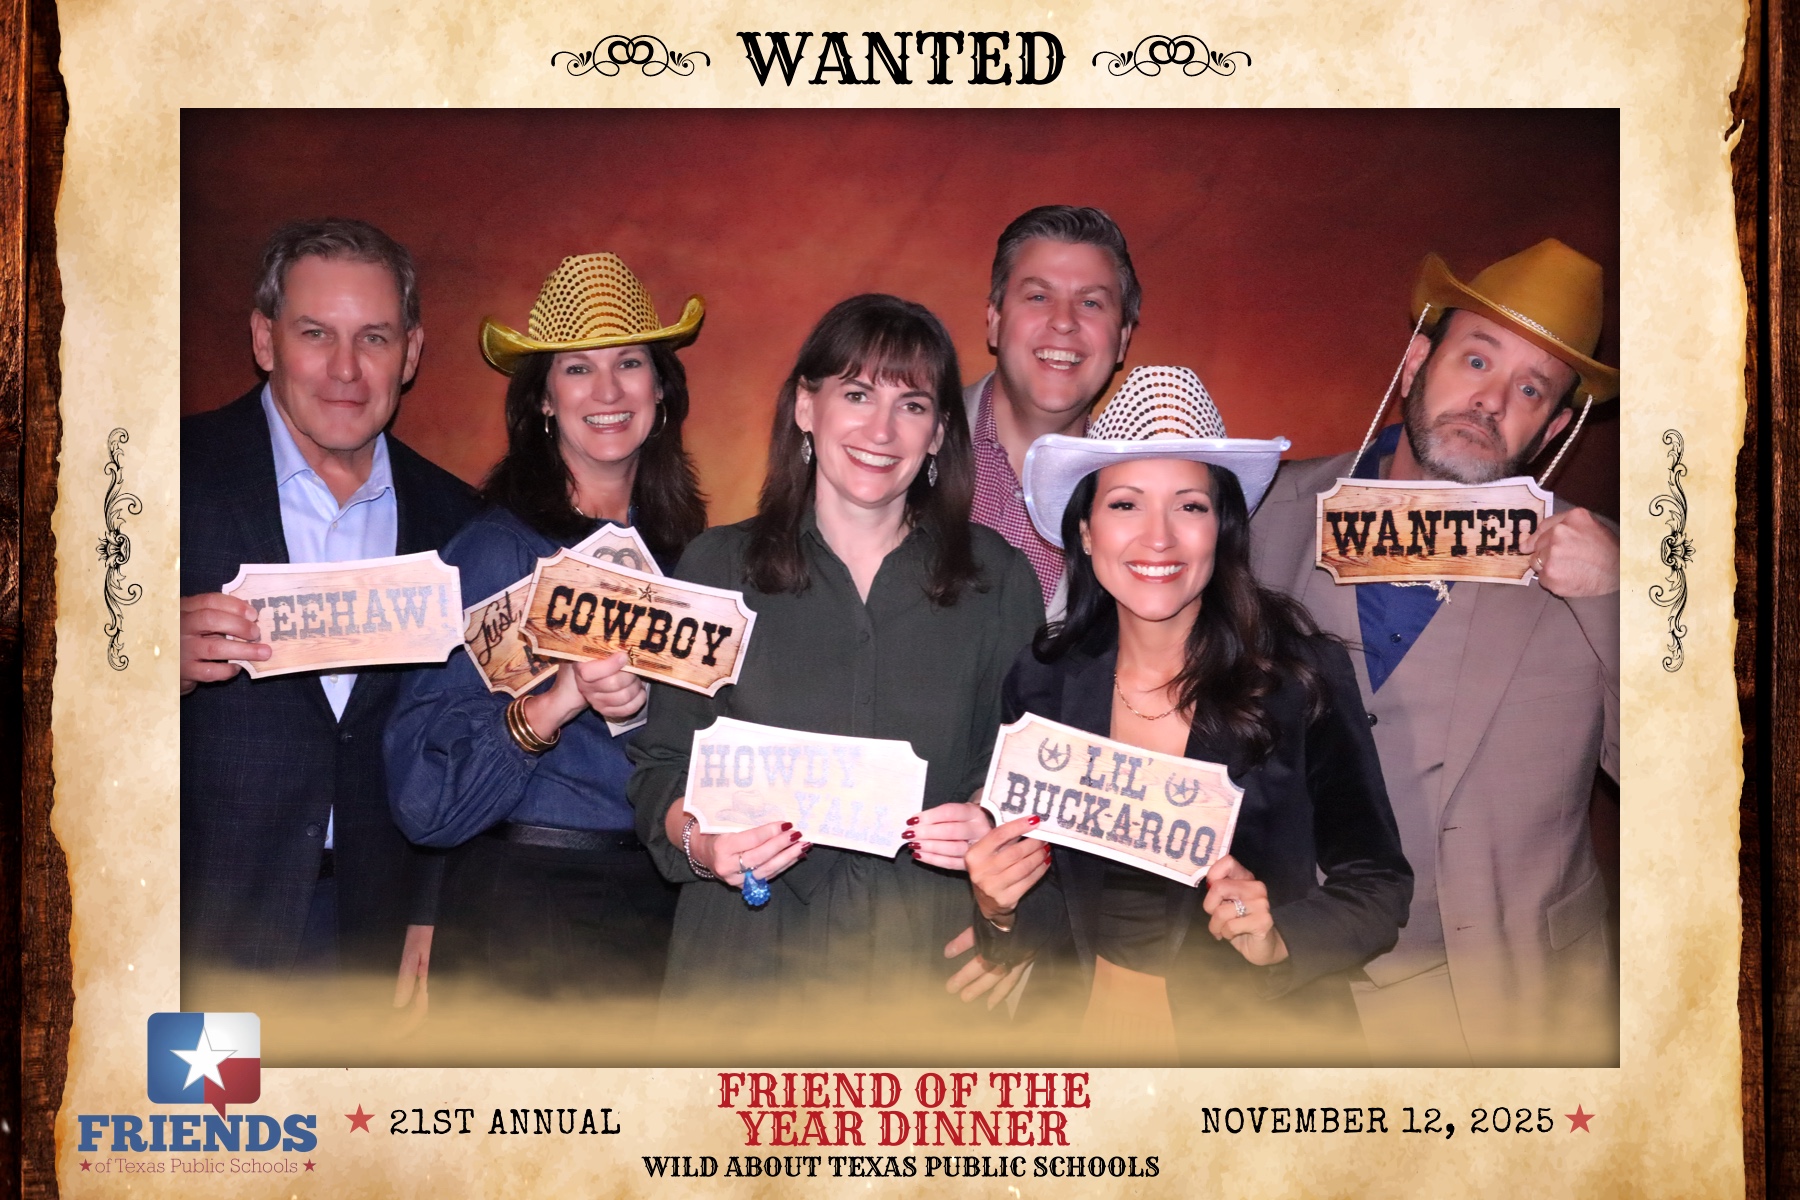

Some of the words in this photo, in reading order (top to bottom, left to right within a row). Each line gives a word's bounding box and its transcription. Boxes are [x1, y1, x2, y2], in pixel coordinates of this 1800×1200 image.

[1326, 508, 1538, 556] WANTED
[464, 591, 518, 667] Just
[546, 585, 734, 667] COWBOY
